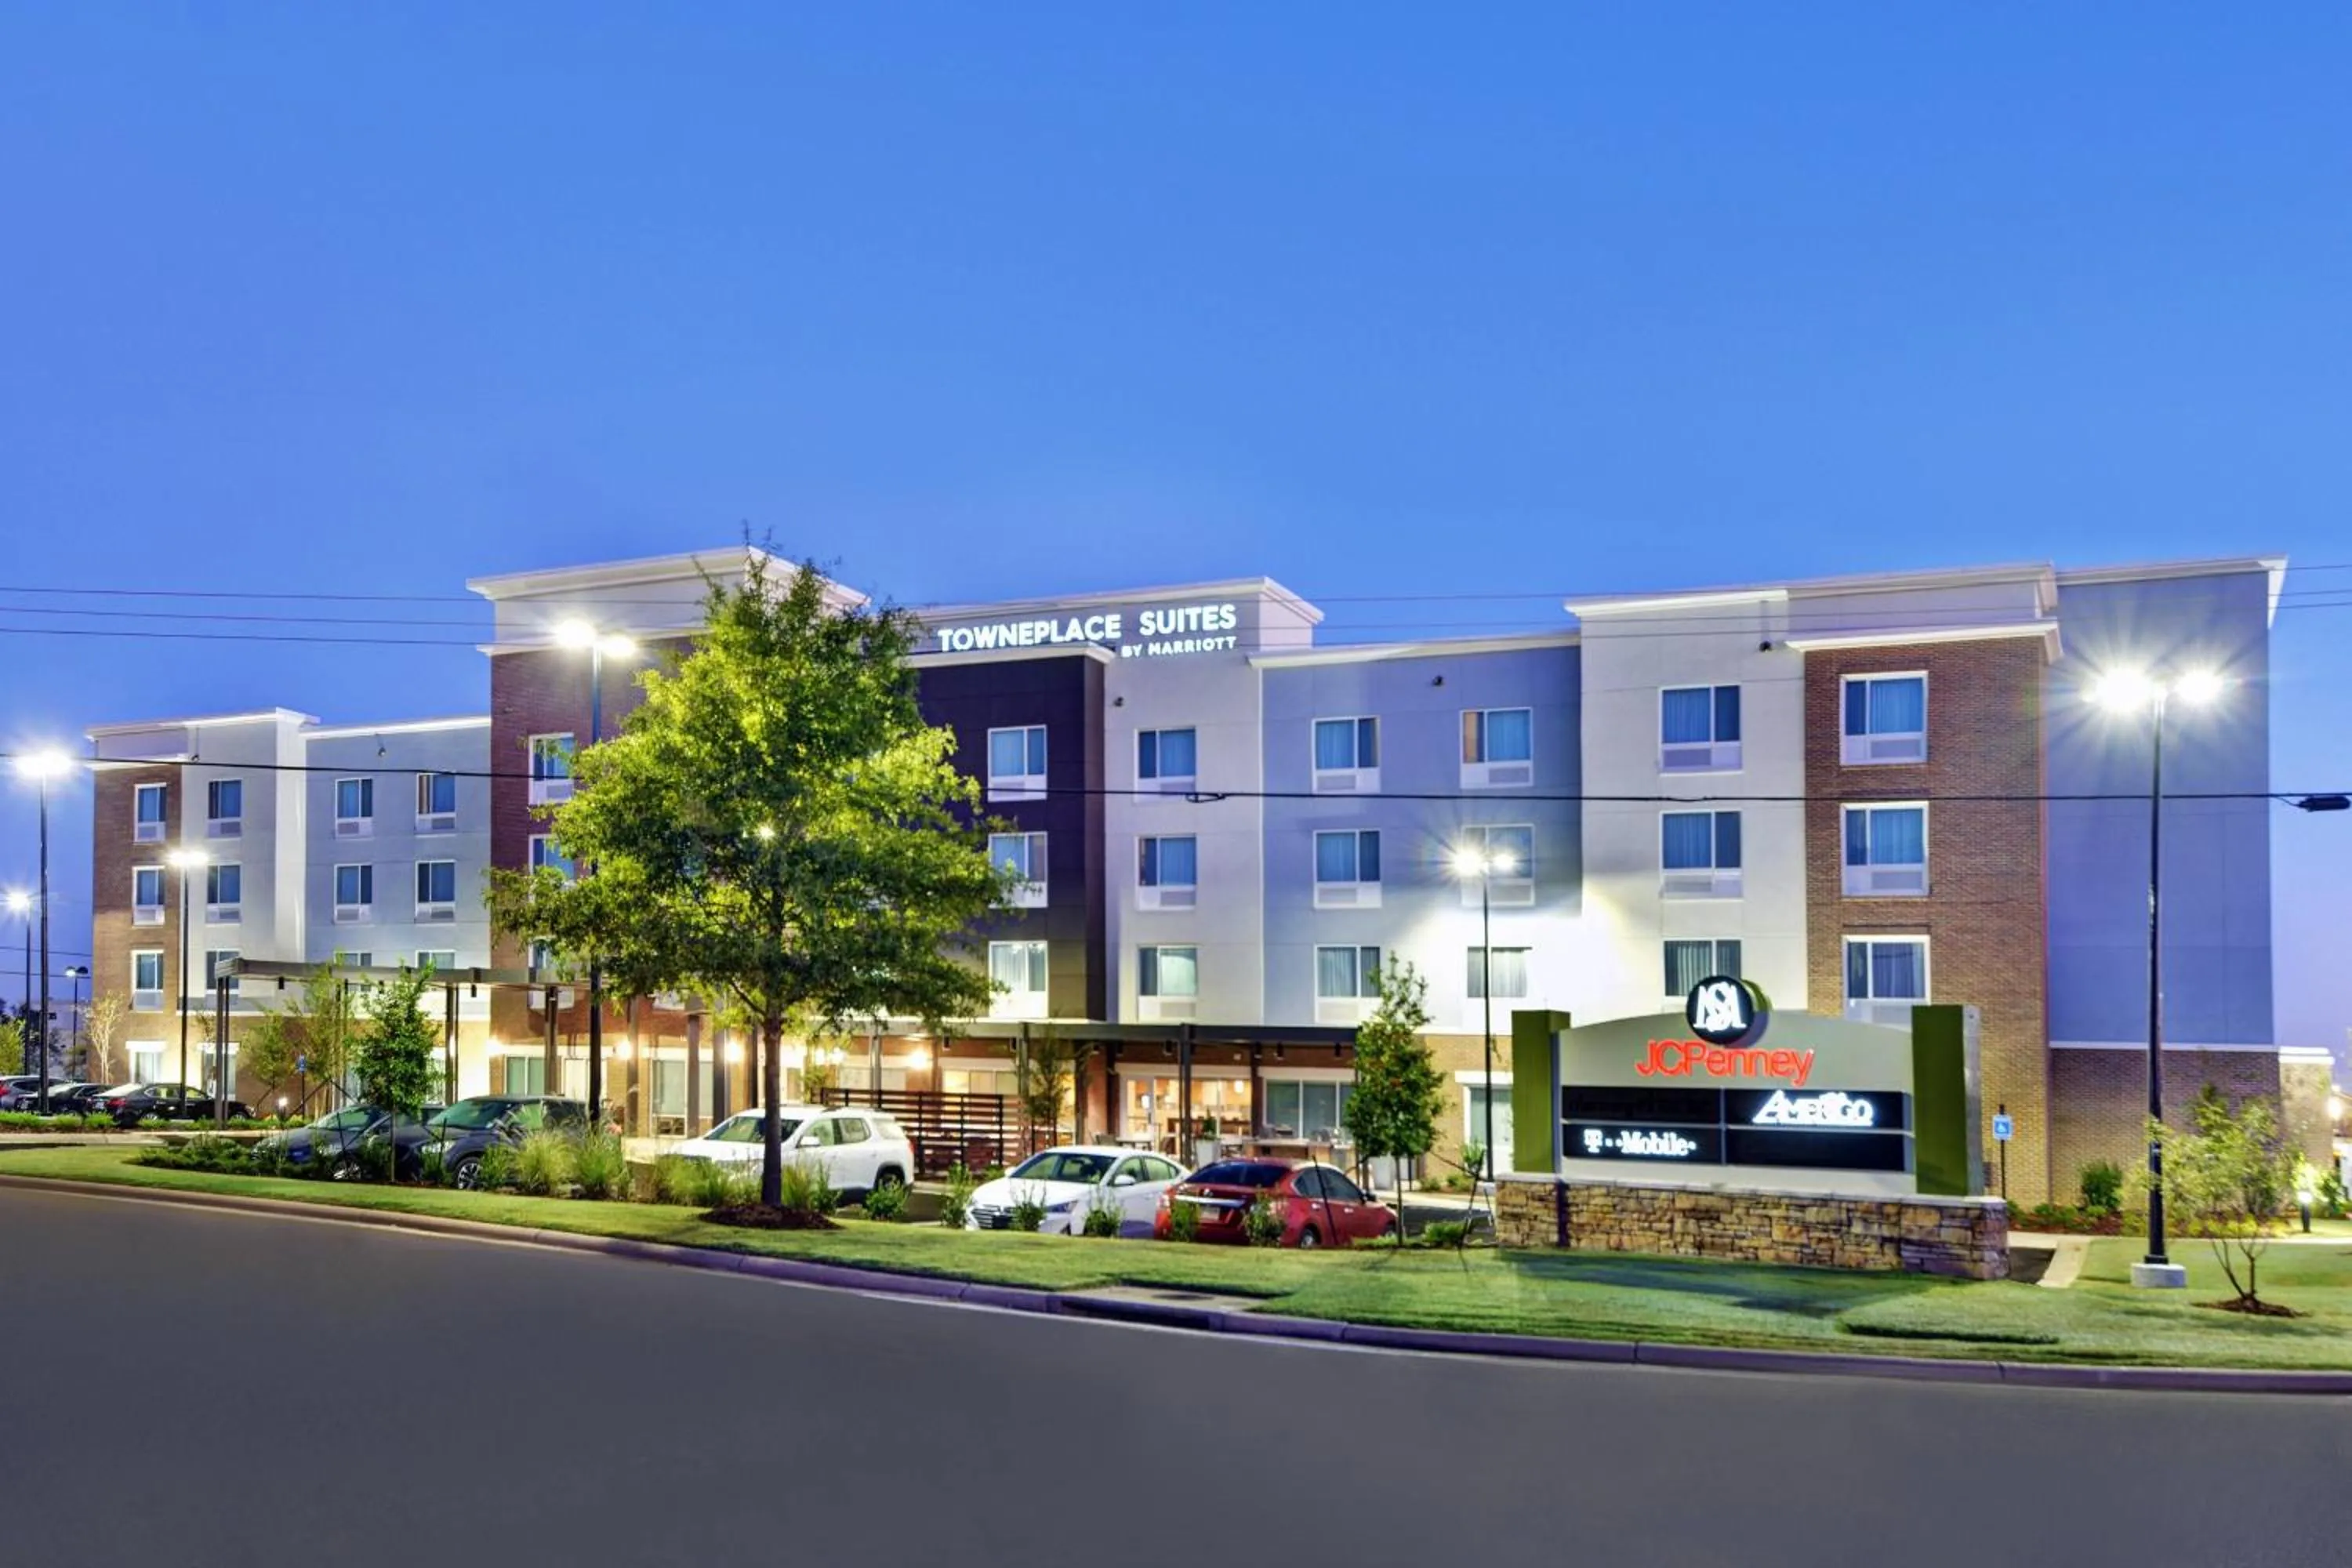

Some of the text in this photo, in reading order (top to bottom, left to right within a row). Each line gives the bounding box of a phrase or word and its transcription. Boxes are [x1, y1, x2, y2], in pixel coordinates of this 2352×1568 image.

[938, 604, 1236, 652] TOWNEPLACE SUITES
[1121, 636, 1236, 658] BY MARRIOTT
[1635, 1038, 1815, 1087] JCPenney
